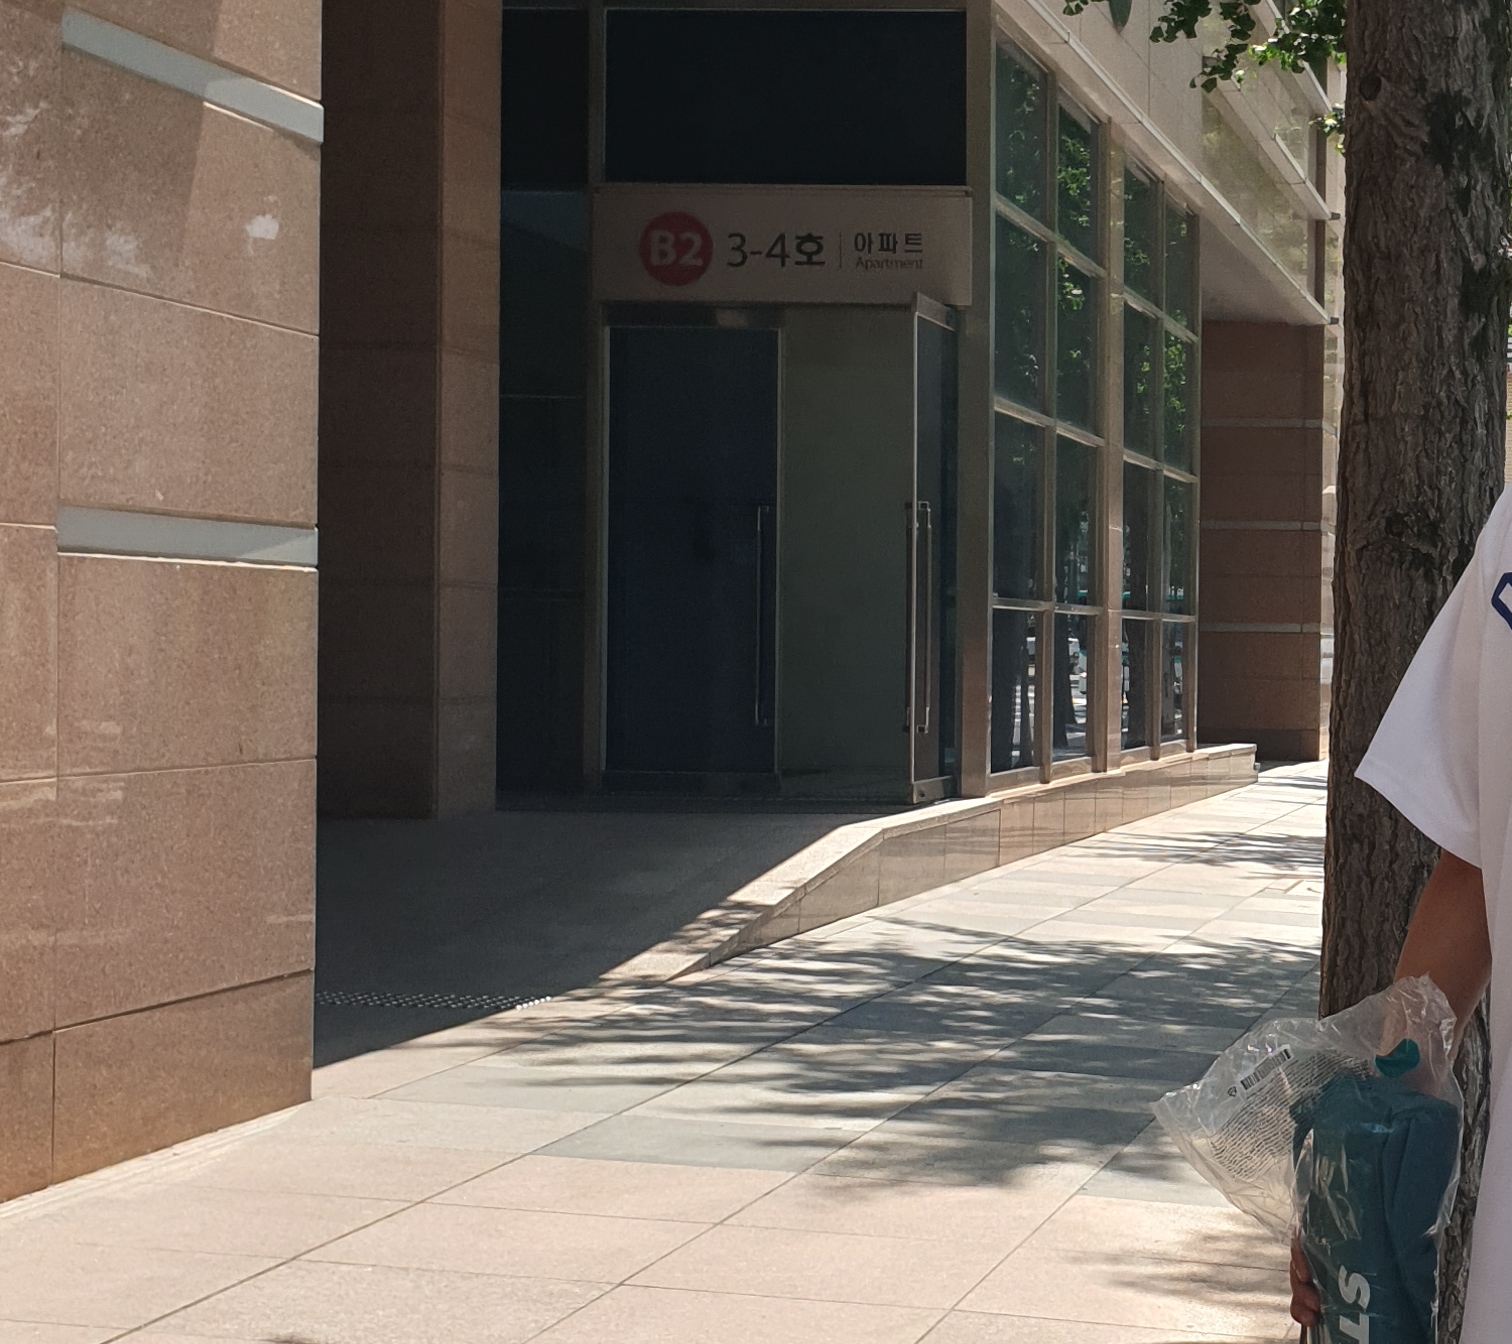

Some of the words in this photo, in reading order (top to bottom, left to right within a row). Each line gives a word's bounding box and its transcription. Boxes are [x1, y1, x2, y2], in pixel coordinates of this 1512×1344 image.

[651, 230, 703, 267] B2
[727, 233, 826, 268] 3-4호
[854, 232, 924, 254] 아파트
[855, 257, 924, 271] Apartment
